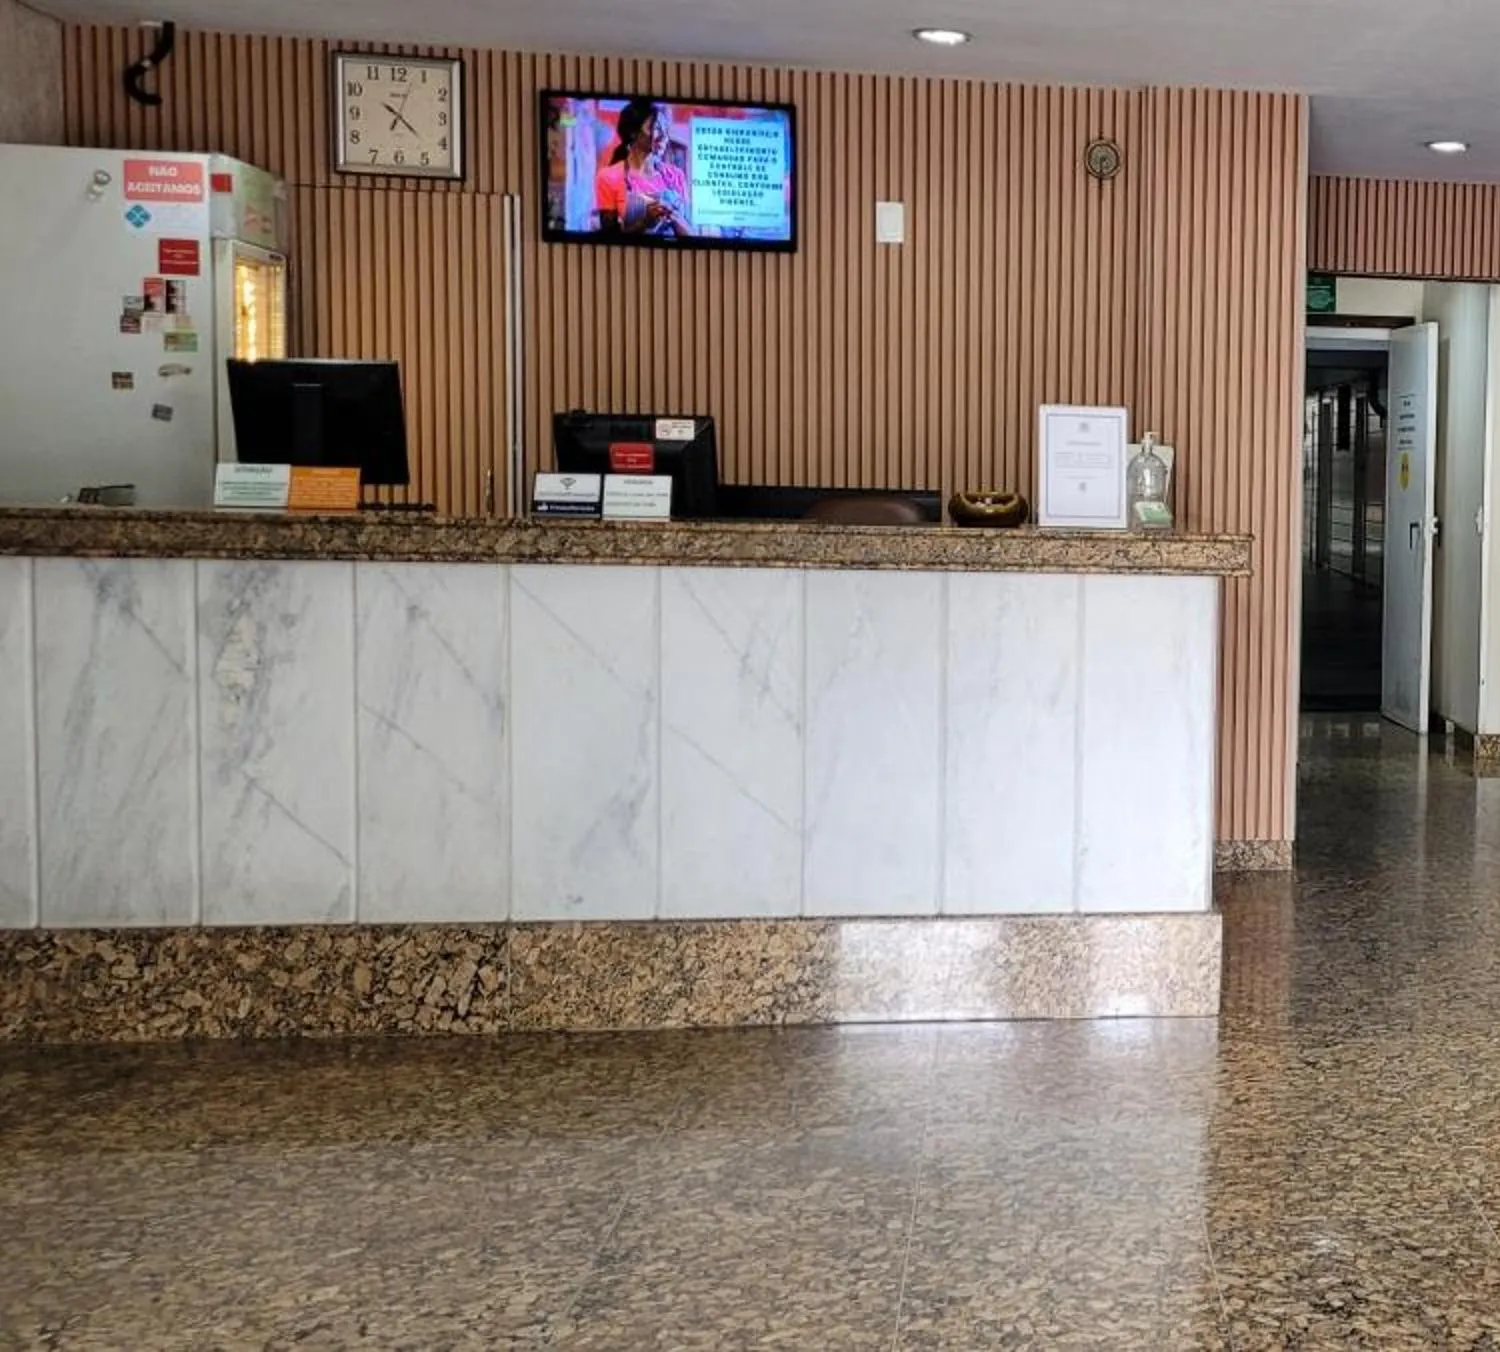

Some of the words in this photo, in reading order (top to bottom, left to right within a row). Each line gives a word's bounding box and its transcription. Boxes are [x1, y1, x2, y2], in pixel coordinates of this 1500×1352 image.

[367, 65, 379, 80] 11
[391, 67, 408, 83] 12
[420, 70, 427, 83] 1
[347, 81, 363, 97] 10
[437, 87, 448, 102] 2
[349, 106, 360, 120] 9
[438, 111, 447, 126] 3
[349, 129, 360, 144] 8
[437, 137, 448, 150] 4
[367, 147, 378, 165] 7
[393, 149, 404, 165] 6
[420, 151, 429, 166] 5
[127, 182, 202, 196] ACEITAMOS
